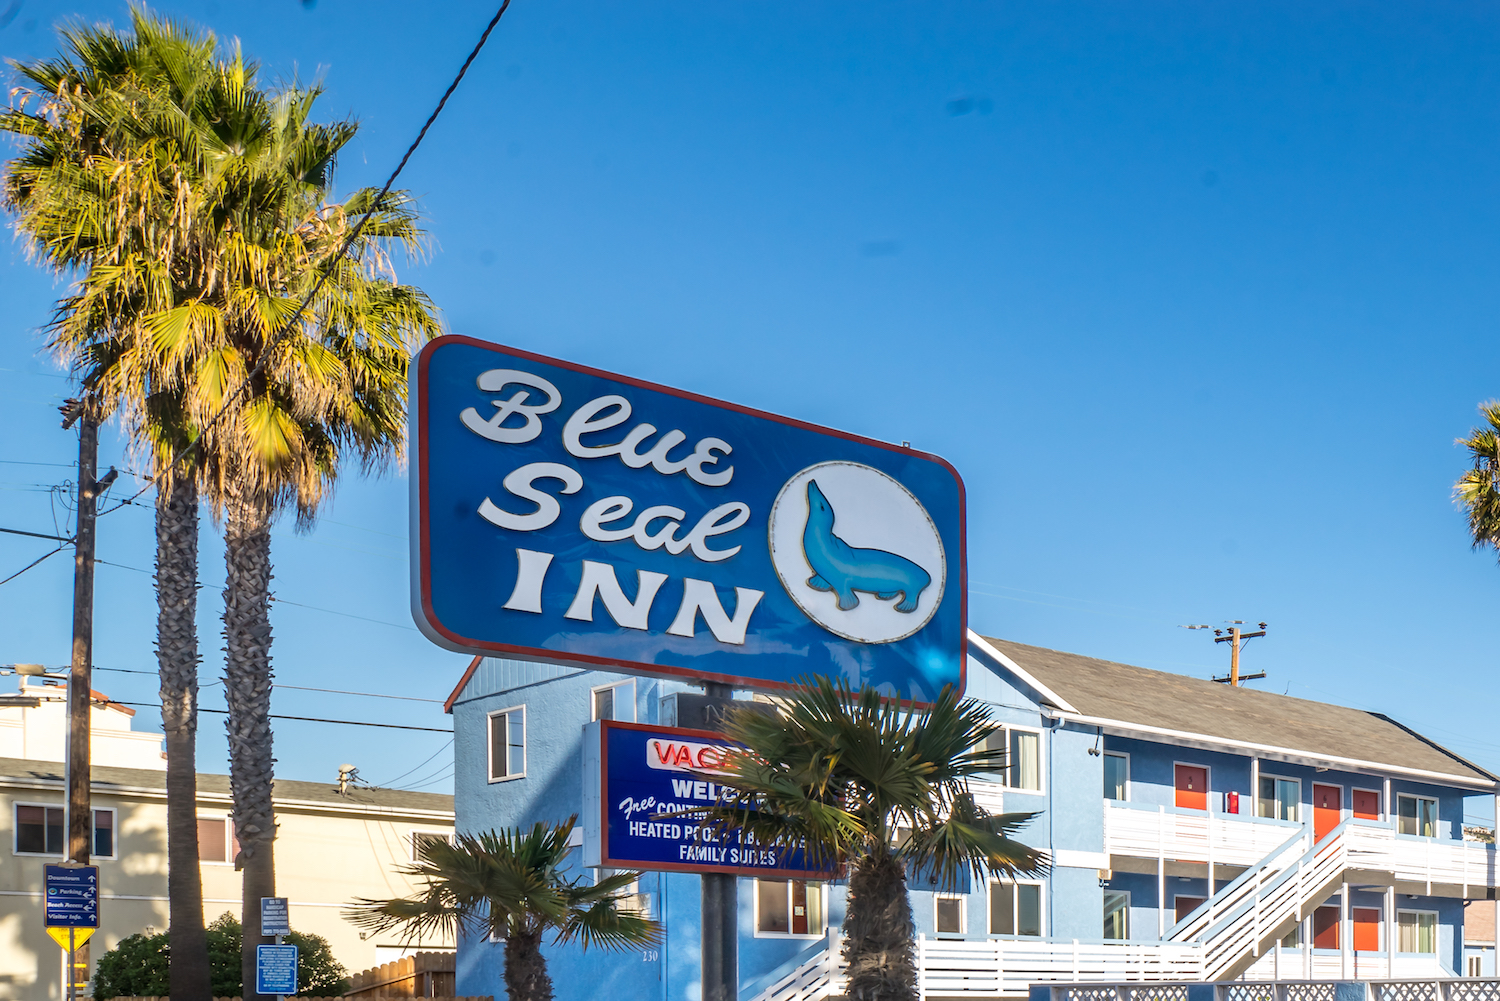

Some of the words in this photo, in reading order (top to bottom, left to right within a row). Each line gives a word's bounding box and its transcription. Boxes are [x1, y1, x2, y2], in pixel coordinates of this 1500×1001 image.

[460, 369, 735, 487] Blue
[477, 462, 751, 562] Seal
[502, 548, 765, 645] INN
[619, 796, 656, 820] Free
[629, 821, 681, 839] HEATED
[680, 845, 728, 862] FAMILY
[730, 848, 776, 866] SUITES
[643, 950, 658, 961] 230
